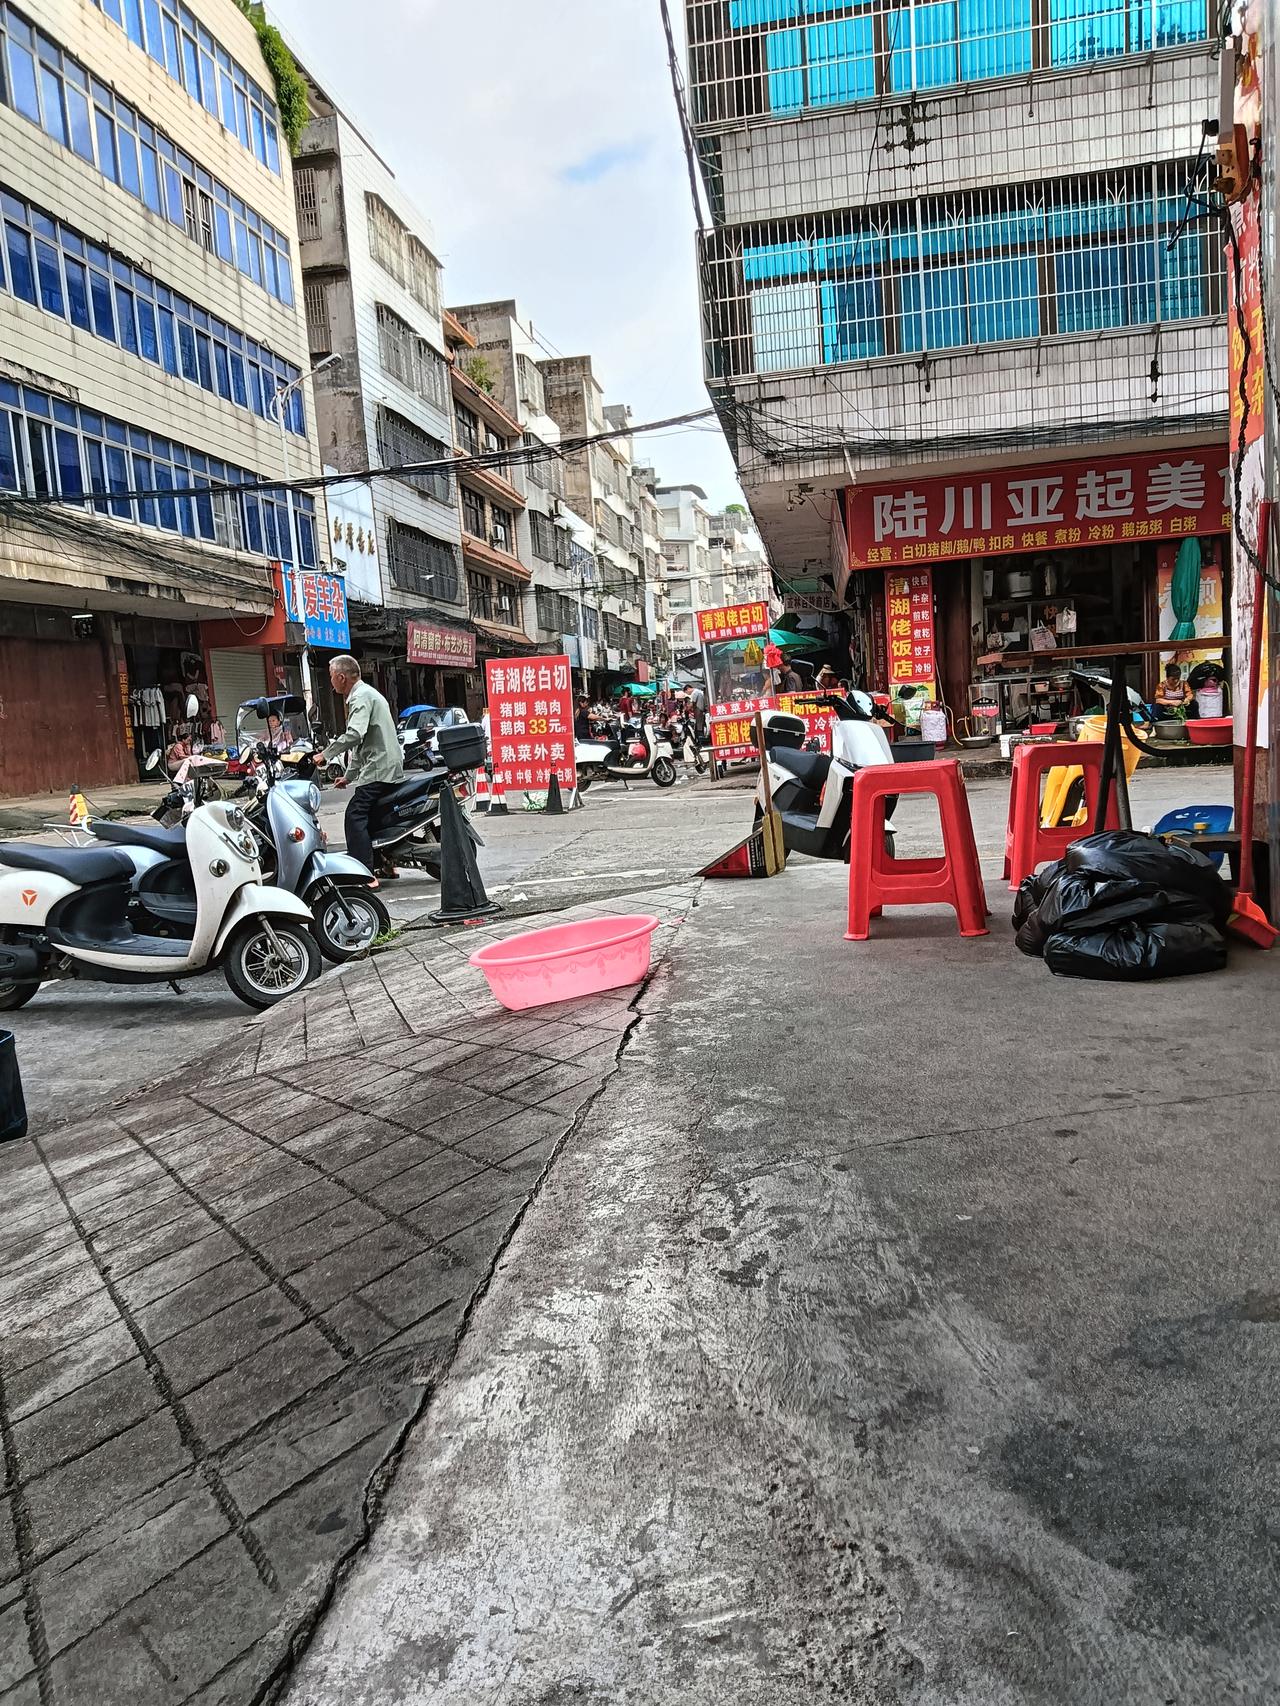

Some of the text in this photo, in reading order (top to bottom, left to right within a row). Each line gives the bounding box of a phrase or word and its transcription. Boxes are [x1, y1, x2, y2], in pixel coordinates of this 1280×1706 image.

[988, 534, 1015, 550] 扣肉
[1021, 530, 1048, 546] 快餐
[1055, 527, 1082, 544] 煮粉
[1088, 523, 1115, 540] 冷粉
[1121, 519, 1163, 537] 鹅汤粥
[1170, 515, 1197, 533] 白粥
[701, 605, 764, 631] 清湖佬白切
[889, 577, 913, 677] 清湖佬饭店
[490, 665, 568, 694] 清湖佬白切
[500, 699, 561, 718] 猪脚 鹅肉
[501, 743, 565, 763] 熟菜外卖
[516, 768, 532, 784] 中餐
[557, 767, 573, 783] 白粥
